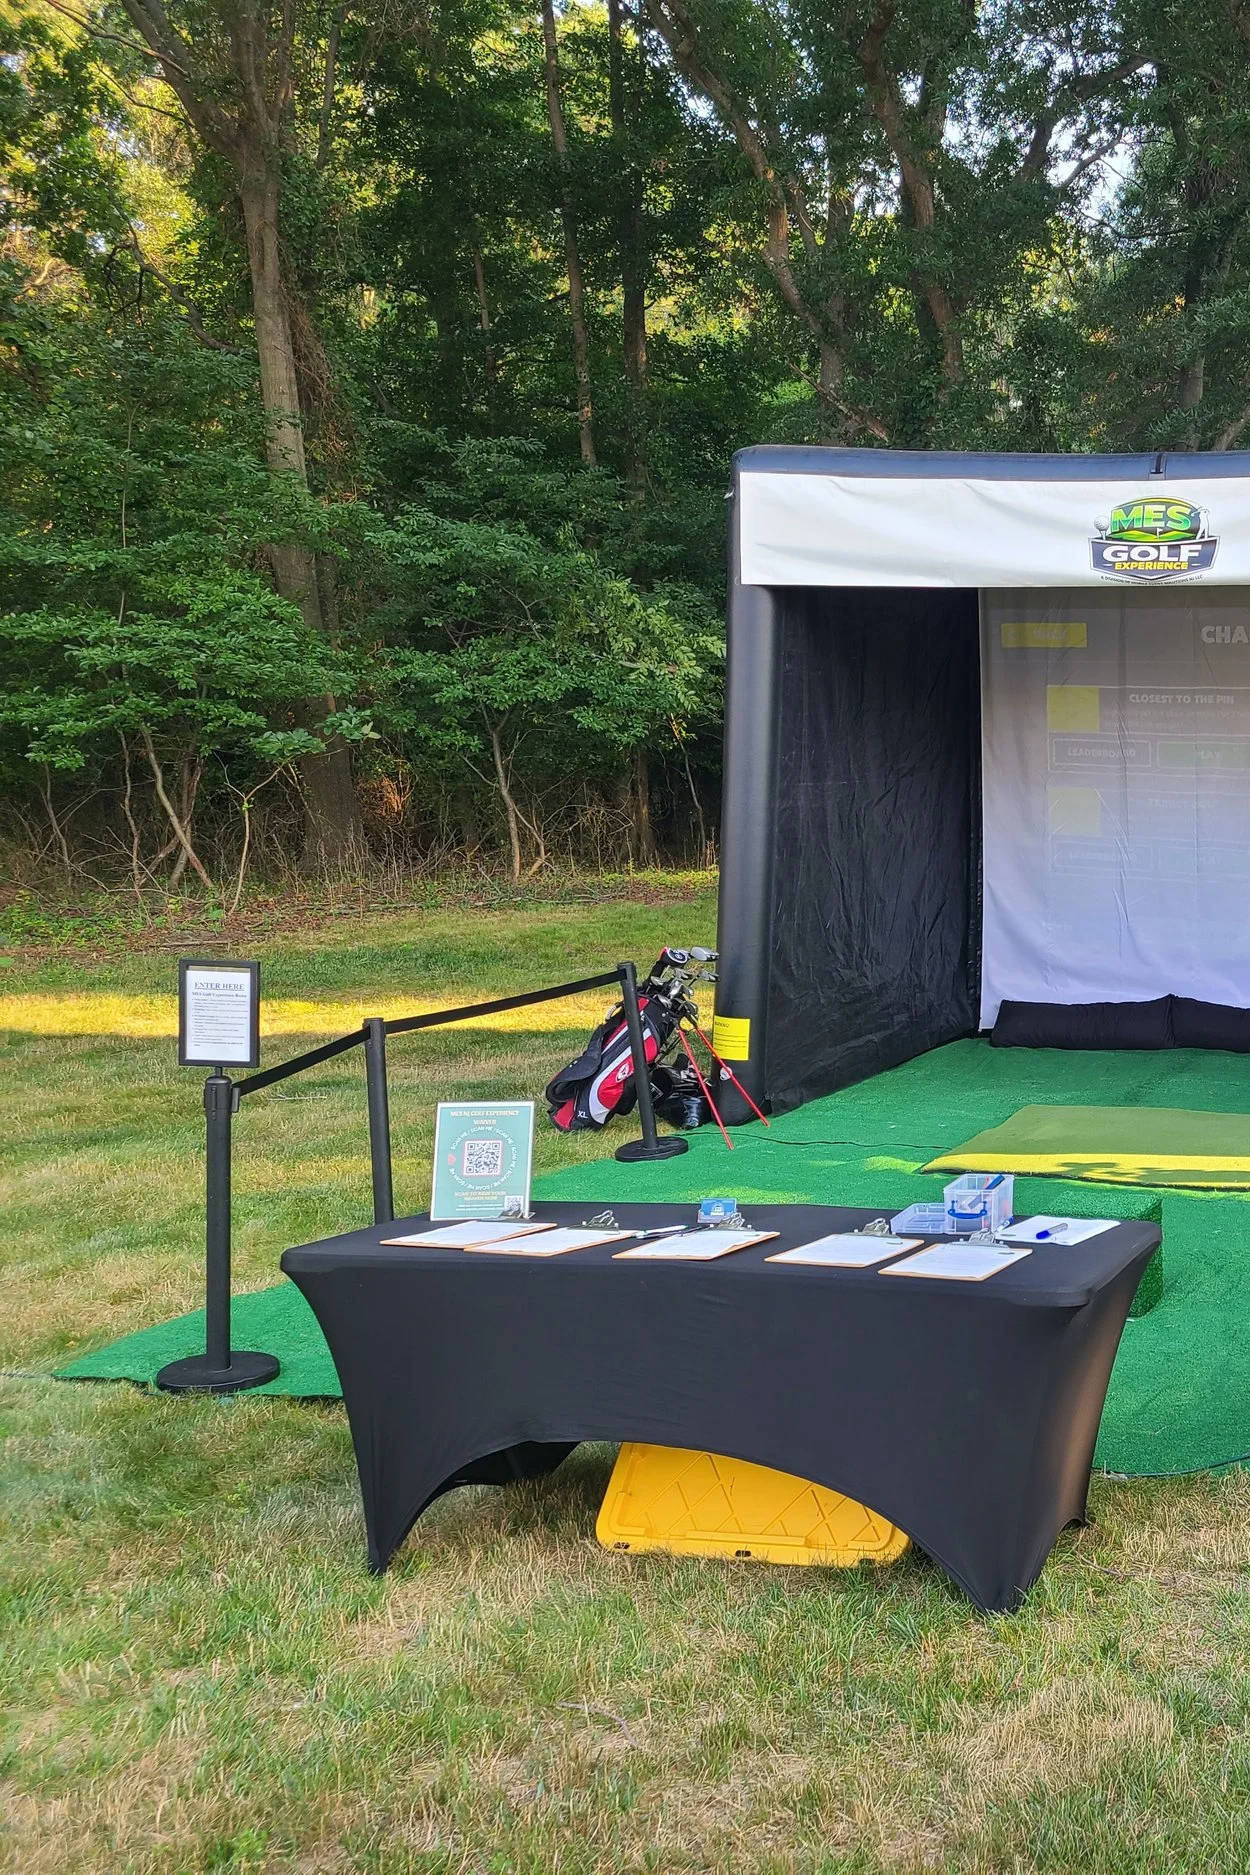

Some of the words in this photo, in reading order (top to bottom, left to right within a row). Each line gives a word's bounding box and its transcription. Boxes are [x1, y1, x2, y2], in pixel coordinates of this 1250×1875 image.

[1111, 504, 1191, 532] MES
[1102, 544, 1202, 562] GOLF
[1114, 561, 1189, 571] EXPERIENCE
[1129, 694, 1173, 704] CLOSEST
[1176, 694, 1191, 704] TO
[1194, 695, 1215, 704] THE
[1216, 695, 1234, 705] PIN
[194, 982, 220, 990] ENTER
[222, 983, 245, 991] HERE
[577, 1110, 588, 1118] XL
